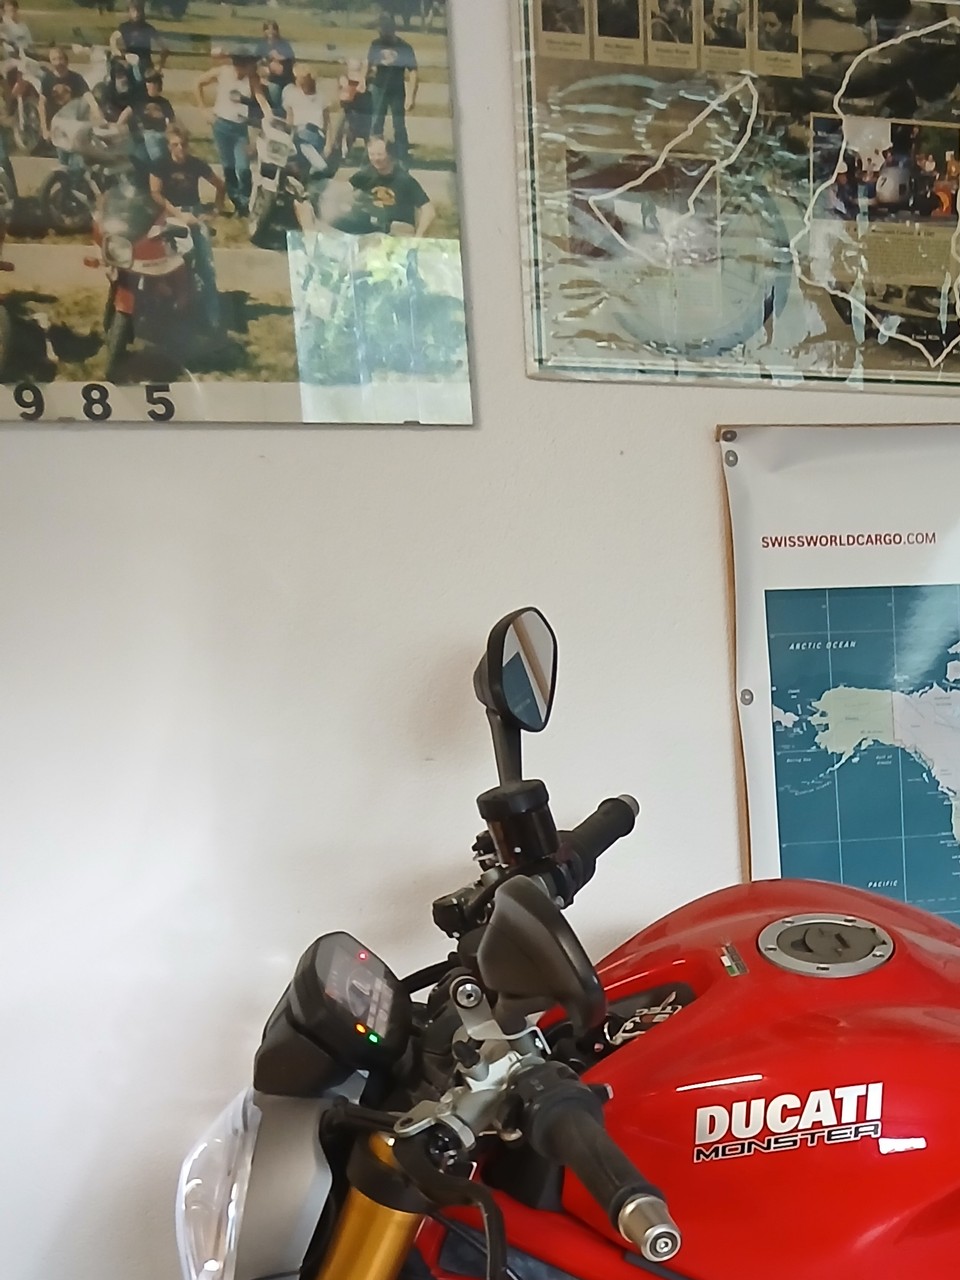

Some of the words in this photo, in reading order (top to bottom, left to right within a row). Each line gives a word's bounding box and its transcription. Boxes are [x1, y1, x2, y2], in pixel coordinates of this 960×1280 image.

[761, 532, 937, 548] SWISSWORLDCARGO.COM
[789, 641, 822, 651] ARCTIC
[825, 640, 857, 650] OCEAN
[867, 879, 898, 888] PACIFIC
[695, 1082, 883, 1145] DUCATI
[694, 1121, 882, 1163] MONSTER
